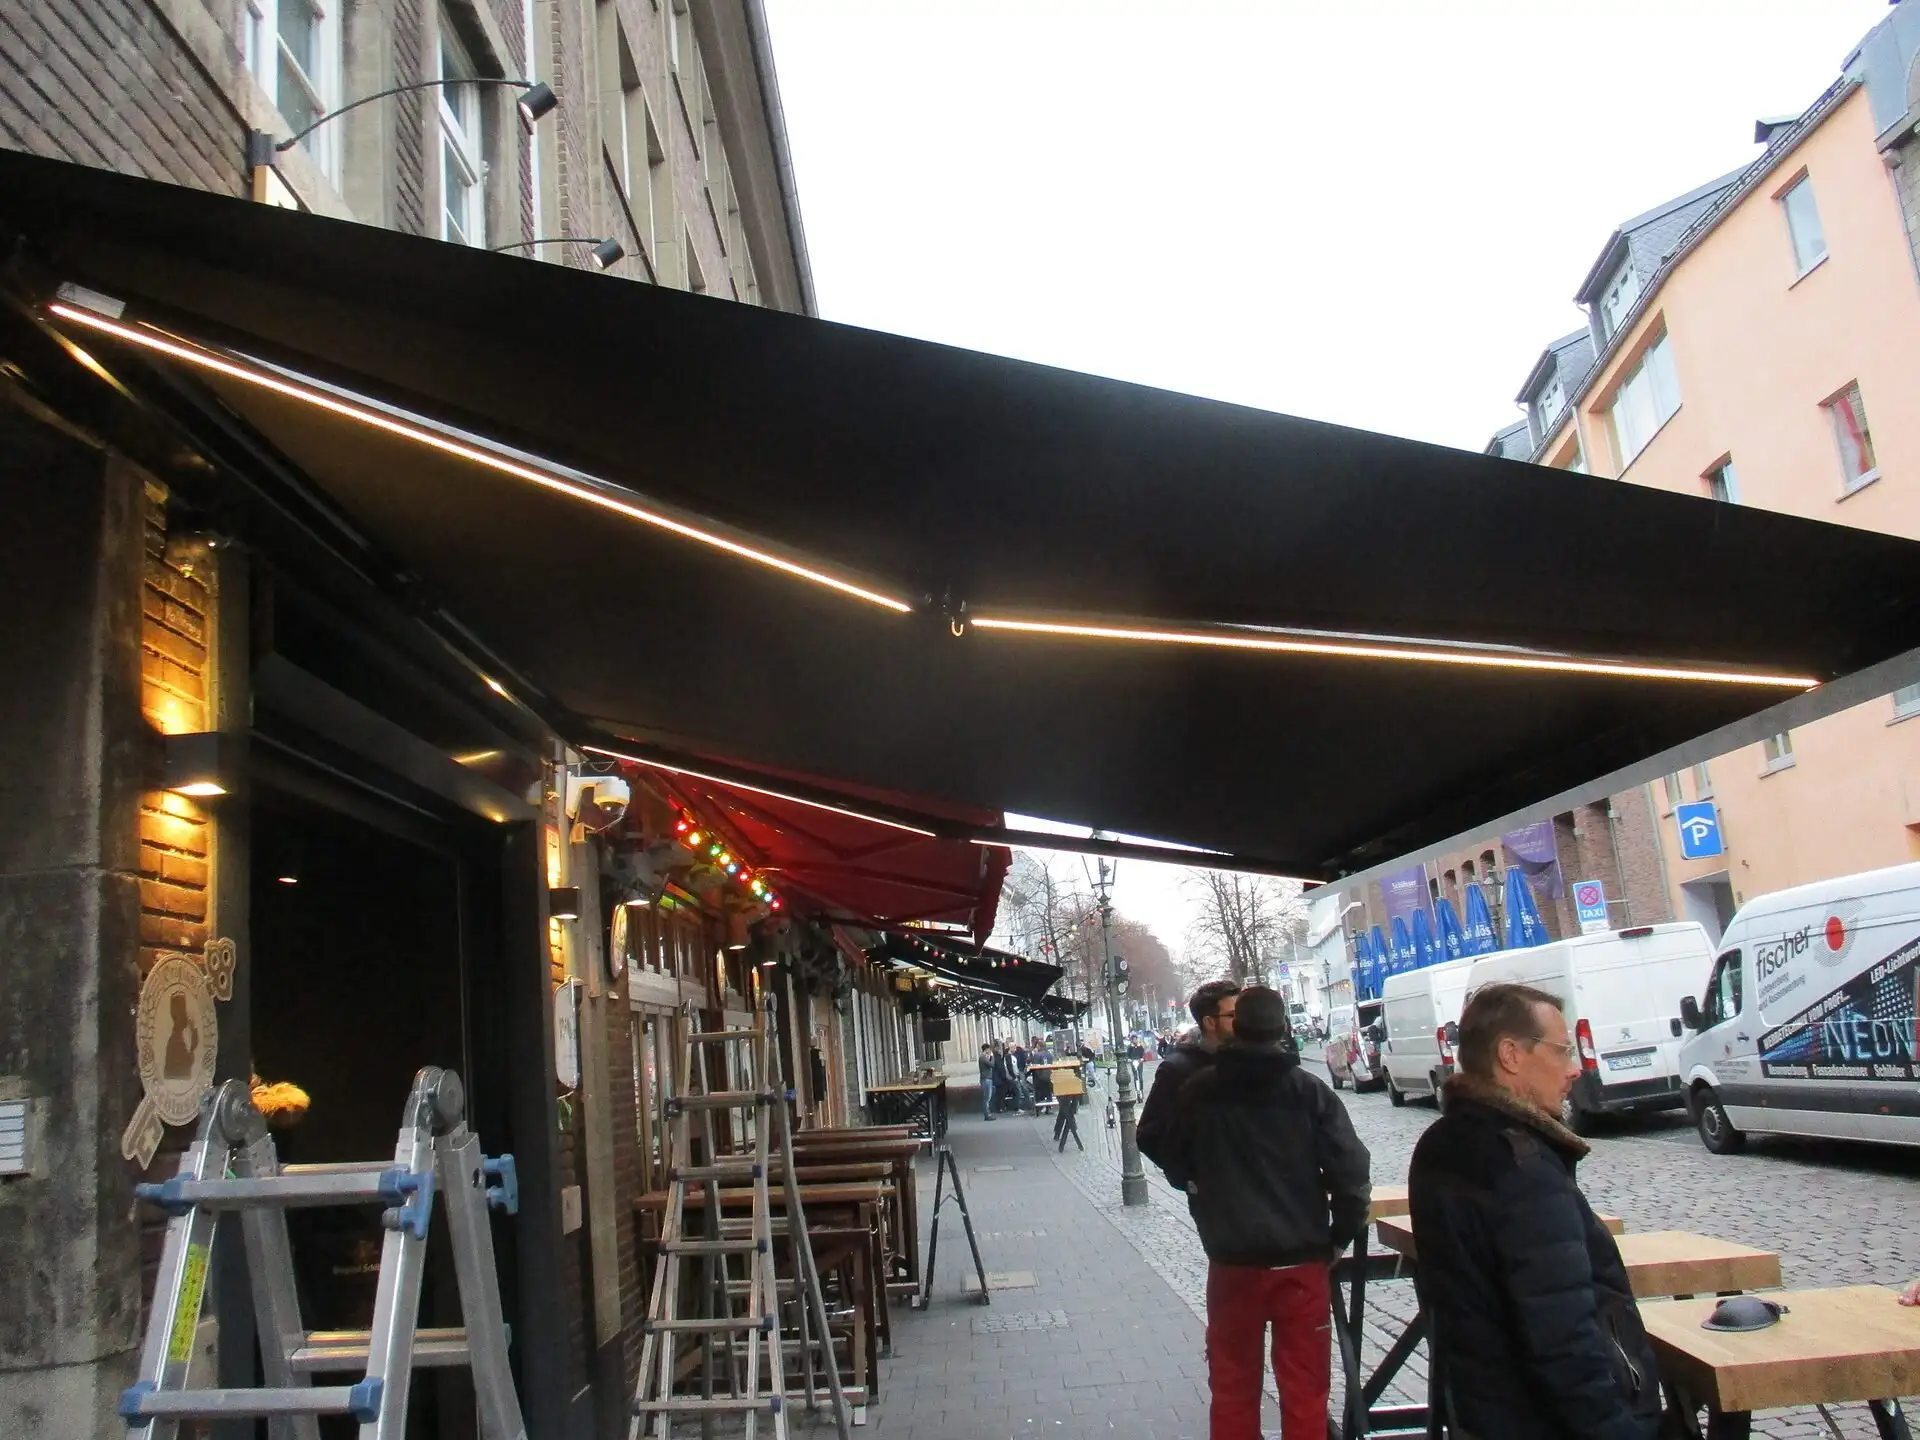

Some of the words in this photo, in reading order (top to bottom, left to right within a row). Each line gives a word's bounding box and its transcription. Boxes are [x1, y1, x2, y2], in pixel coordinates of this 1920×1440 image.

[1691, 824, 1708, 846] P
[1580, 907, 1604, 919] TAXI
[1756, 924, 1811, 982] fischer
[1870, 941, 1920, 984] LED-Lichtwer
[1824, 1004, 1914, 1061] NEON
